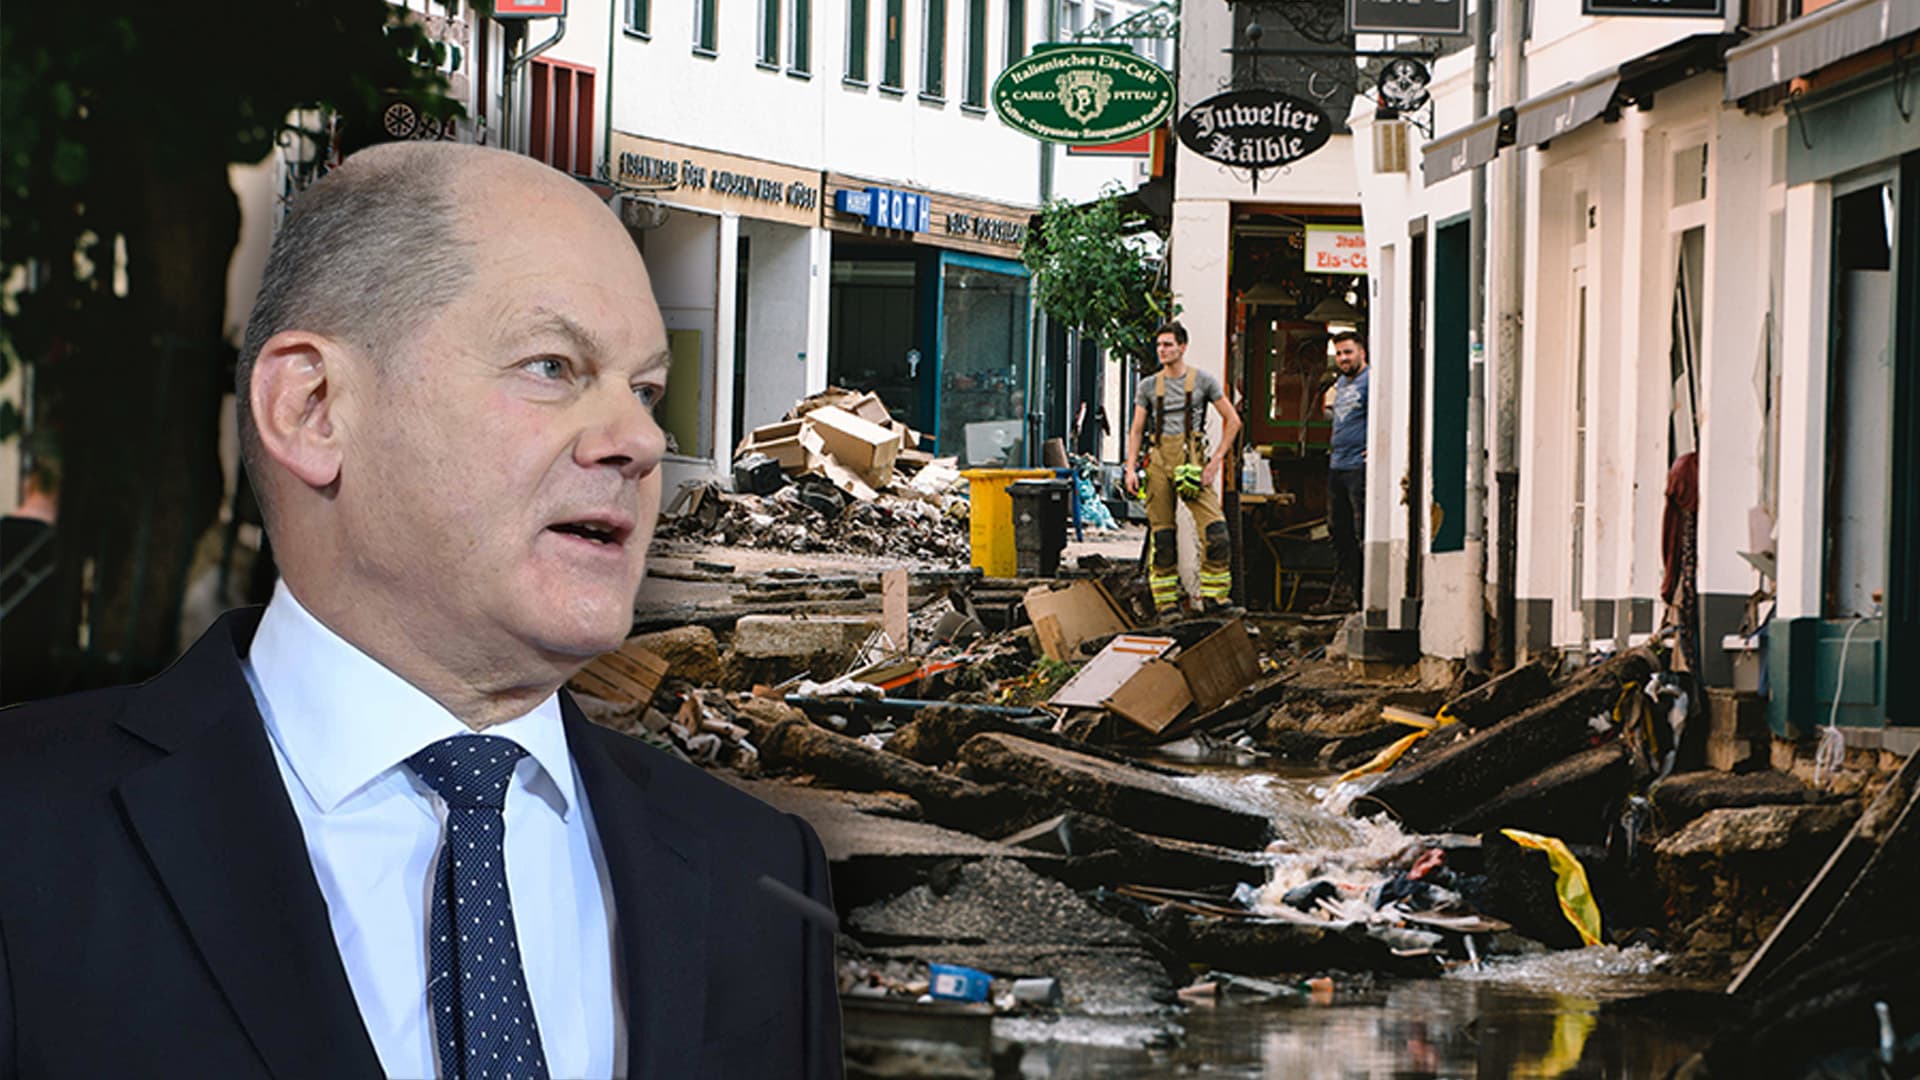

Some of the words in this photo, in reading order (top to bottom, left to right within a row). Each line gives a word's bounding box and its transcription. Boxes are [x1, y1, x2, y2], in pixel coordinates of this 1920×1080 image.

[1010, 54, 1095, 85] Italienisches
[1098, 54, 1158, 85] Eis-Café
[1012, 91, 1055, 100] CARLO
[1113, 91, 1157, 100] PITTAU
[1190, 101, 1319, 139] Juwelier
[1204, 131, 1305, 163] Kälble
[877, 191, 931, 233] ROTH
